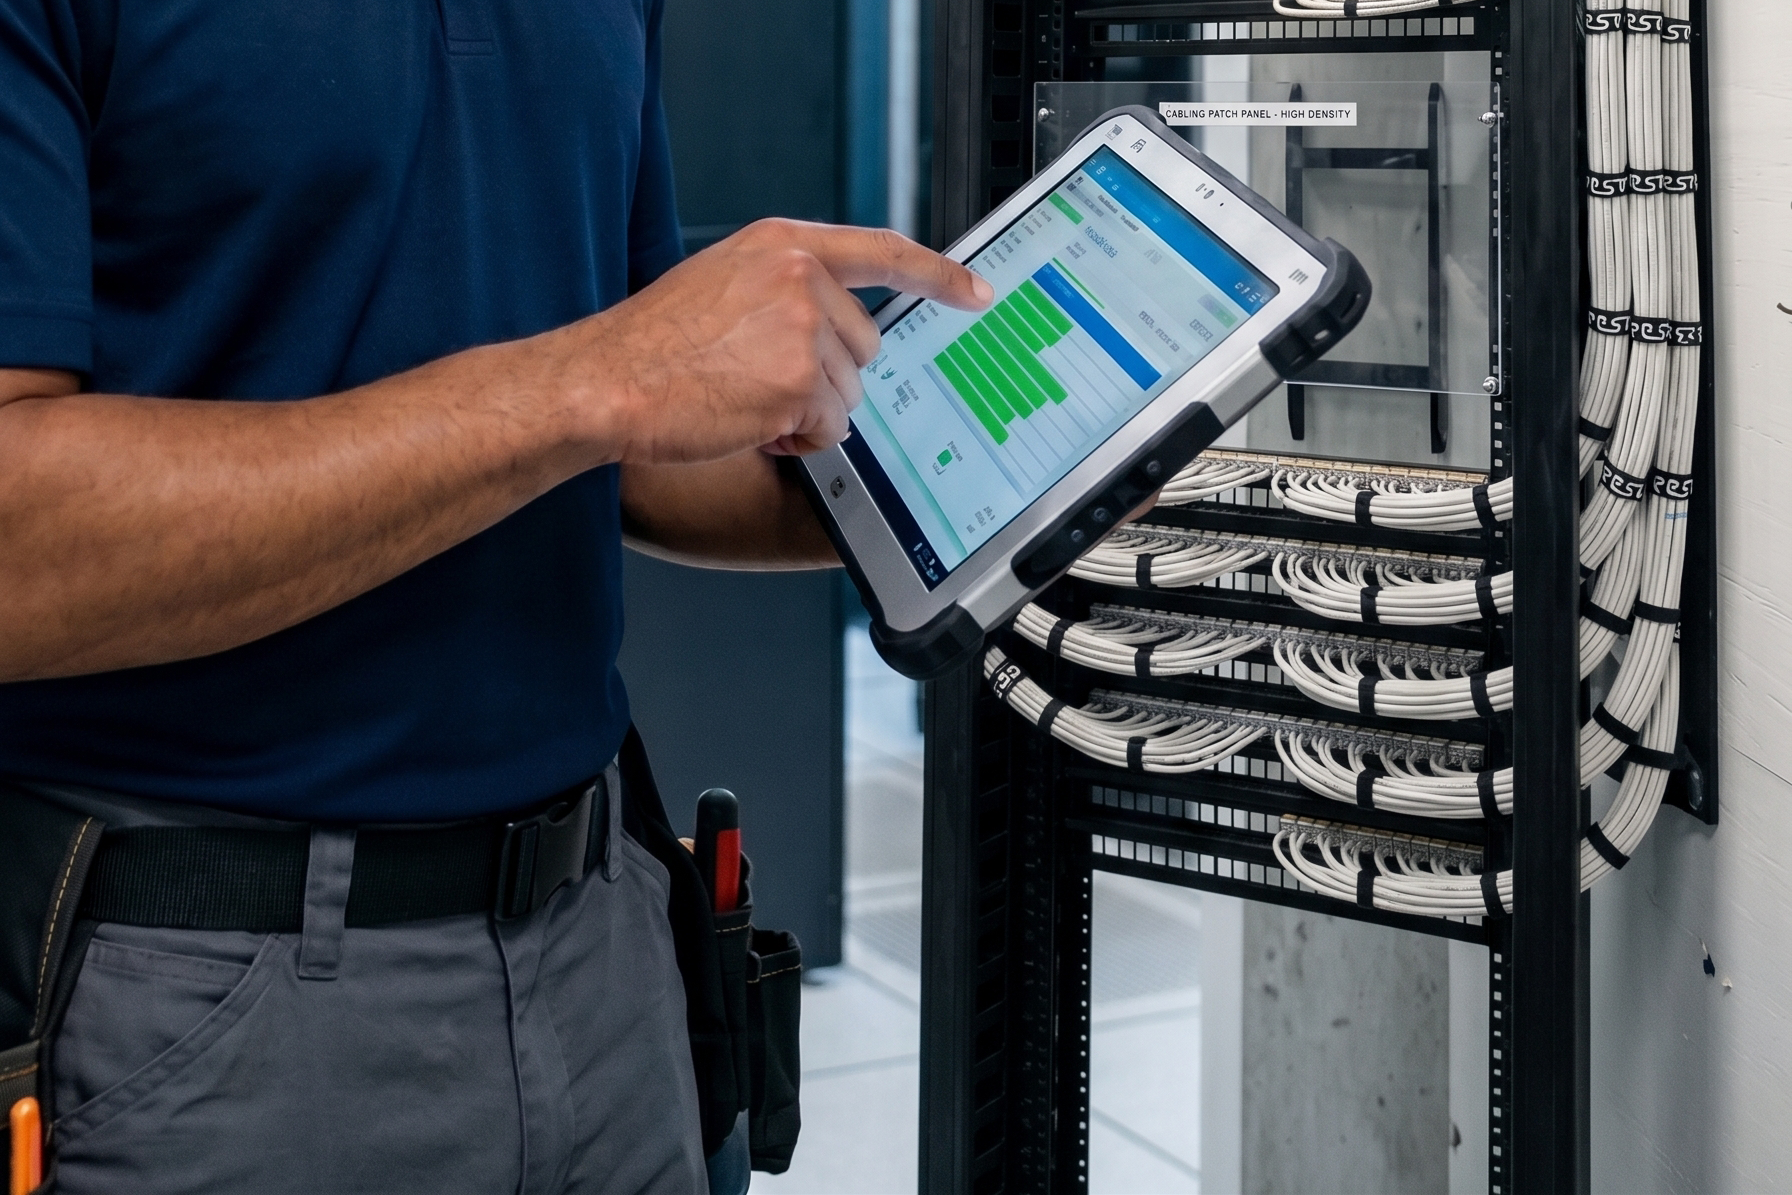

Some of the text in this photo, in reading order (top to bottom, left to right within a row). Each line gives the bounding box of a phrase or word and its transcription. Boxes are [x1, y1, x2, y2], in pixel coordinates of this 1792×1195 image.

[1165, 109, 1206, 119] CABLING
[1208, 109, 1238, 119] PATCH
[1241, 109, 1271, 119] PANEL
[1280, 109, 1305, 119] HIGH
[1308, 109, 1351, 119] DENSITY
